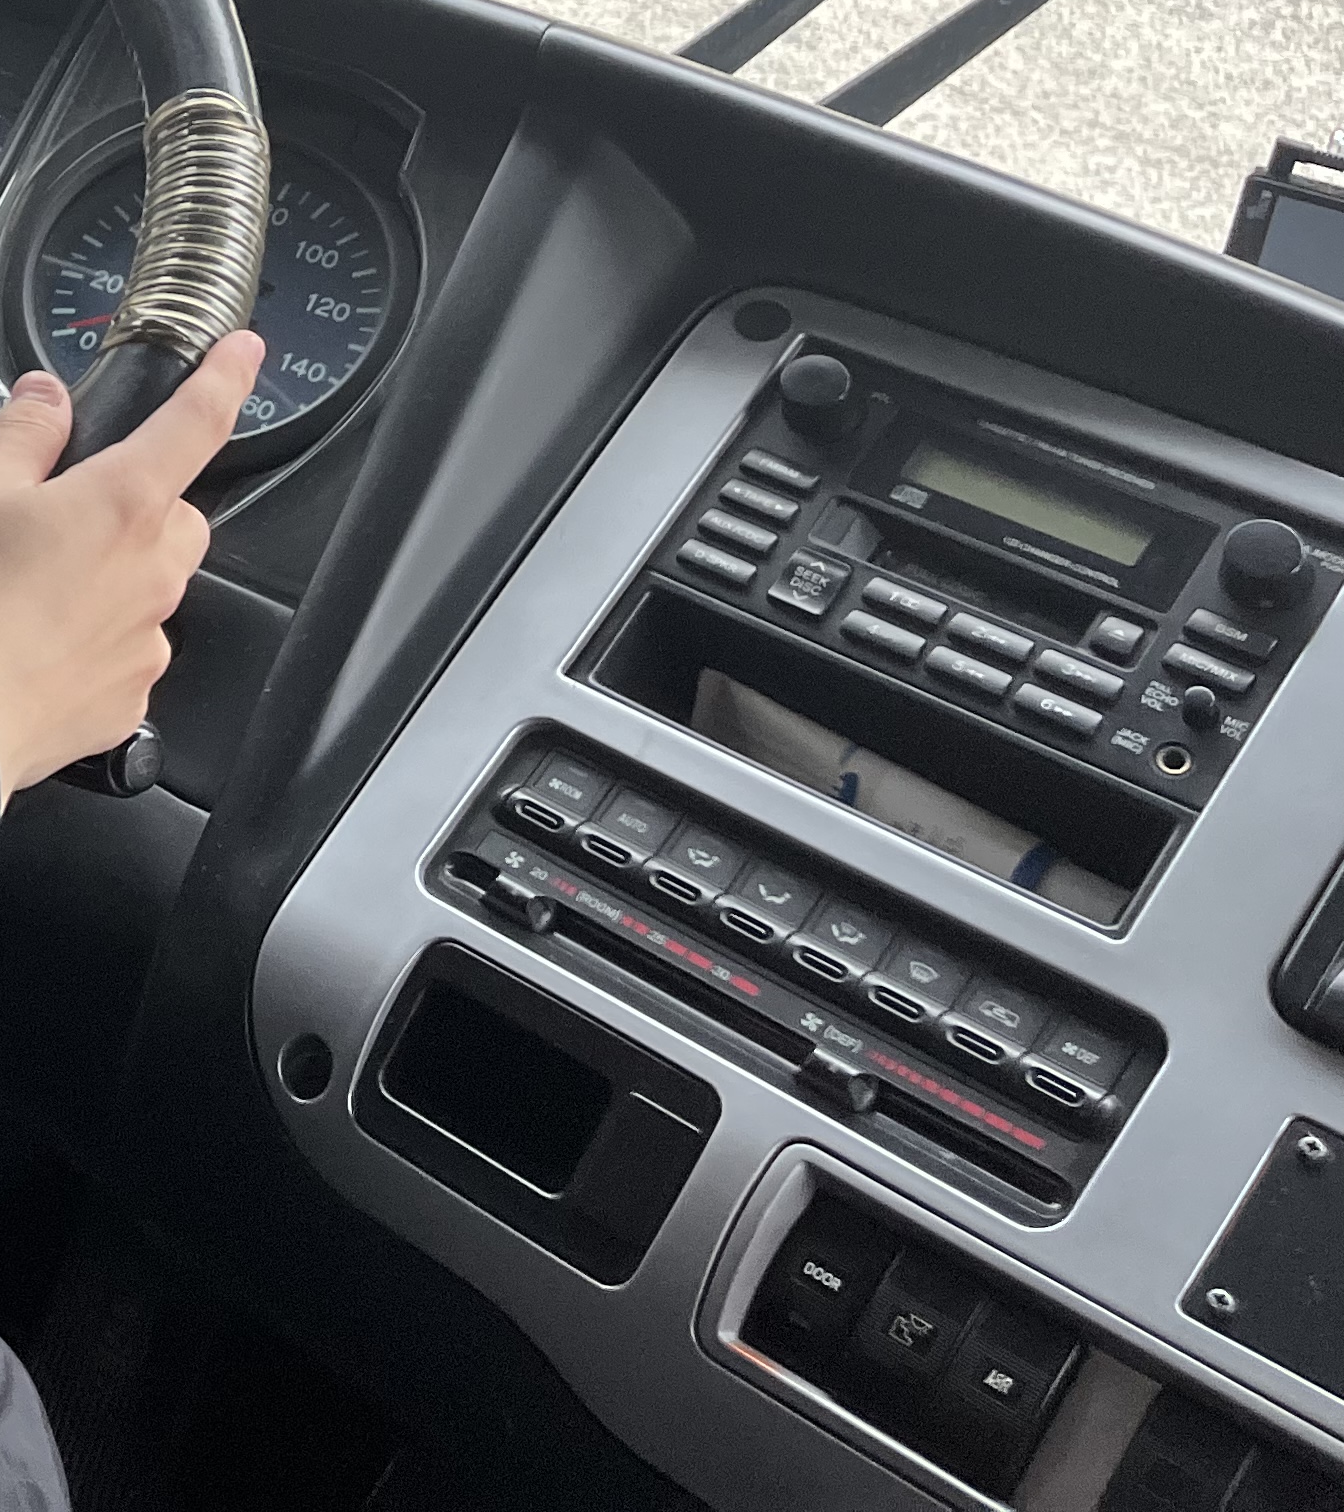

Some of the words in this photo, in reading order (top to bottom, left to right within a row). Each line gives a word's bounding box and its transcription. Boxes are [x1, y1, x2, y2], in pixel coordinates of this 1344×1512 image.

[294, 240, 340, 269] 100
[89, 270, 125, 294] 20
[305, 292, 351, 323] 120
[78, 330, 98, 351] 0
[279, 352, 328, 383] 140
[240, 393, 276, 421] 60
[789, 575, 823, 597] DISC
[794, 565, 831, 588] SEEK
[1179, 652, 1239, 683] MIC/MIX
[1140, 694, 1164, 712] VOL
[1144, 688, 1180, 707] ECHO
[1220, 724, 1243, 741] VOL
[1223, 716, 1250, 731] MIC
[1116, 727, 1151, 746] JACK
[560, 780, 584, 800] ROOM
[617, 813, 648, 834] AUTO
[575, 888, 623, 922] (ROOM)
[822, 1024, 863, 1054] (DEF)
[1075, 1047, 1101, 1065] DEF
[802, 1261, 843, 1292] DOOR
